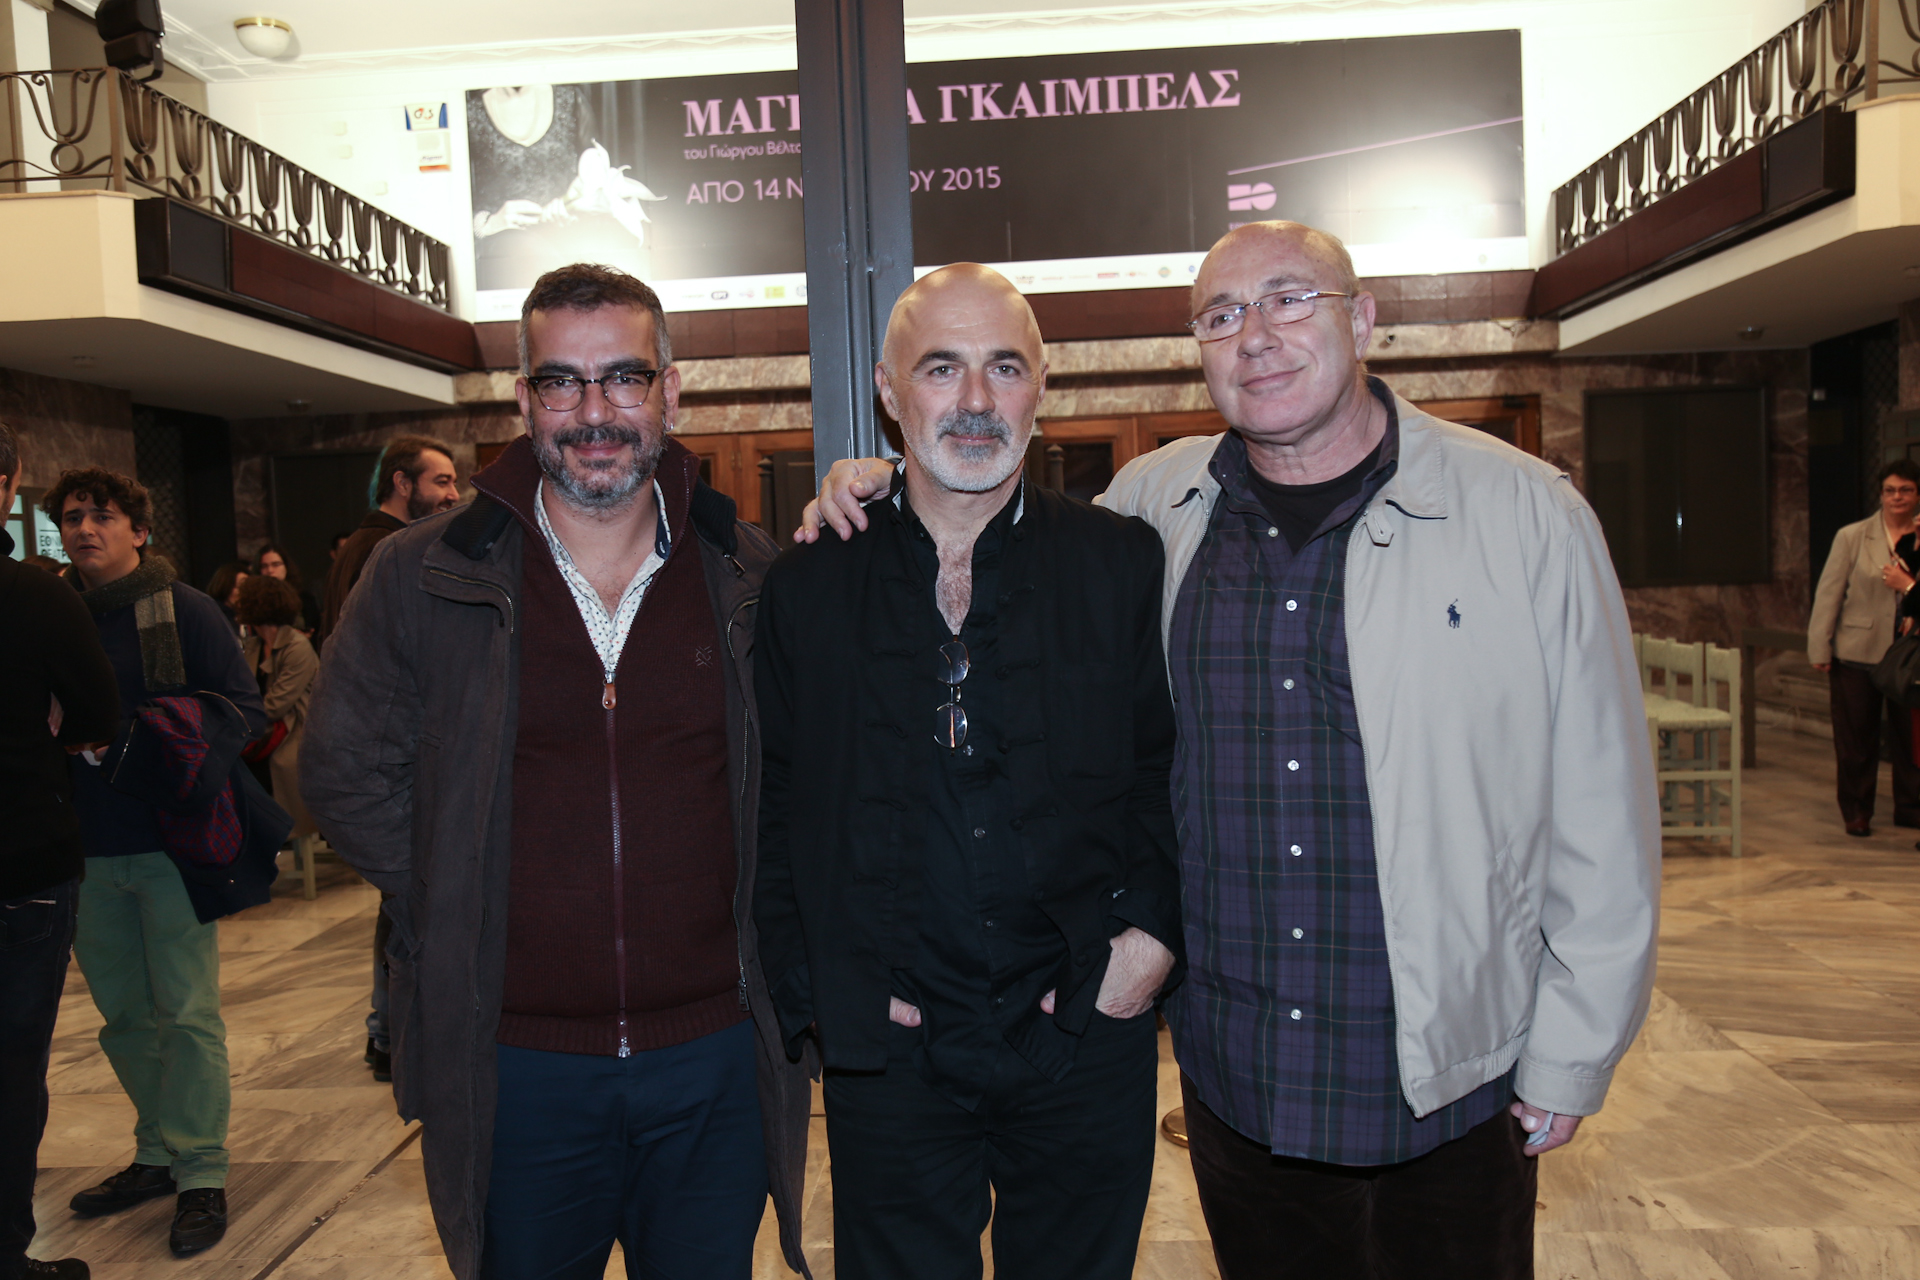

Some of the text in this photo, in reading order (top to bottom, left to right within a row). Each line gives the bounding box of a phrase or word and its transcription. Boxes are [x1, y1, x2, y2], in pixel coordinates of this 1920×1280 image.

[938, 69, 1241, 123] ΓΚΑΙΜΠΕΛΣ
[683, 140, 802, 161] του Γιώργου Βέλτ
[686, 180, 744, 205] ΑΠΟ
[753, 178, 781, 201] 14
[942, 166, 1001, 191] 2015
